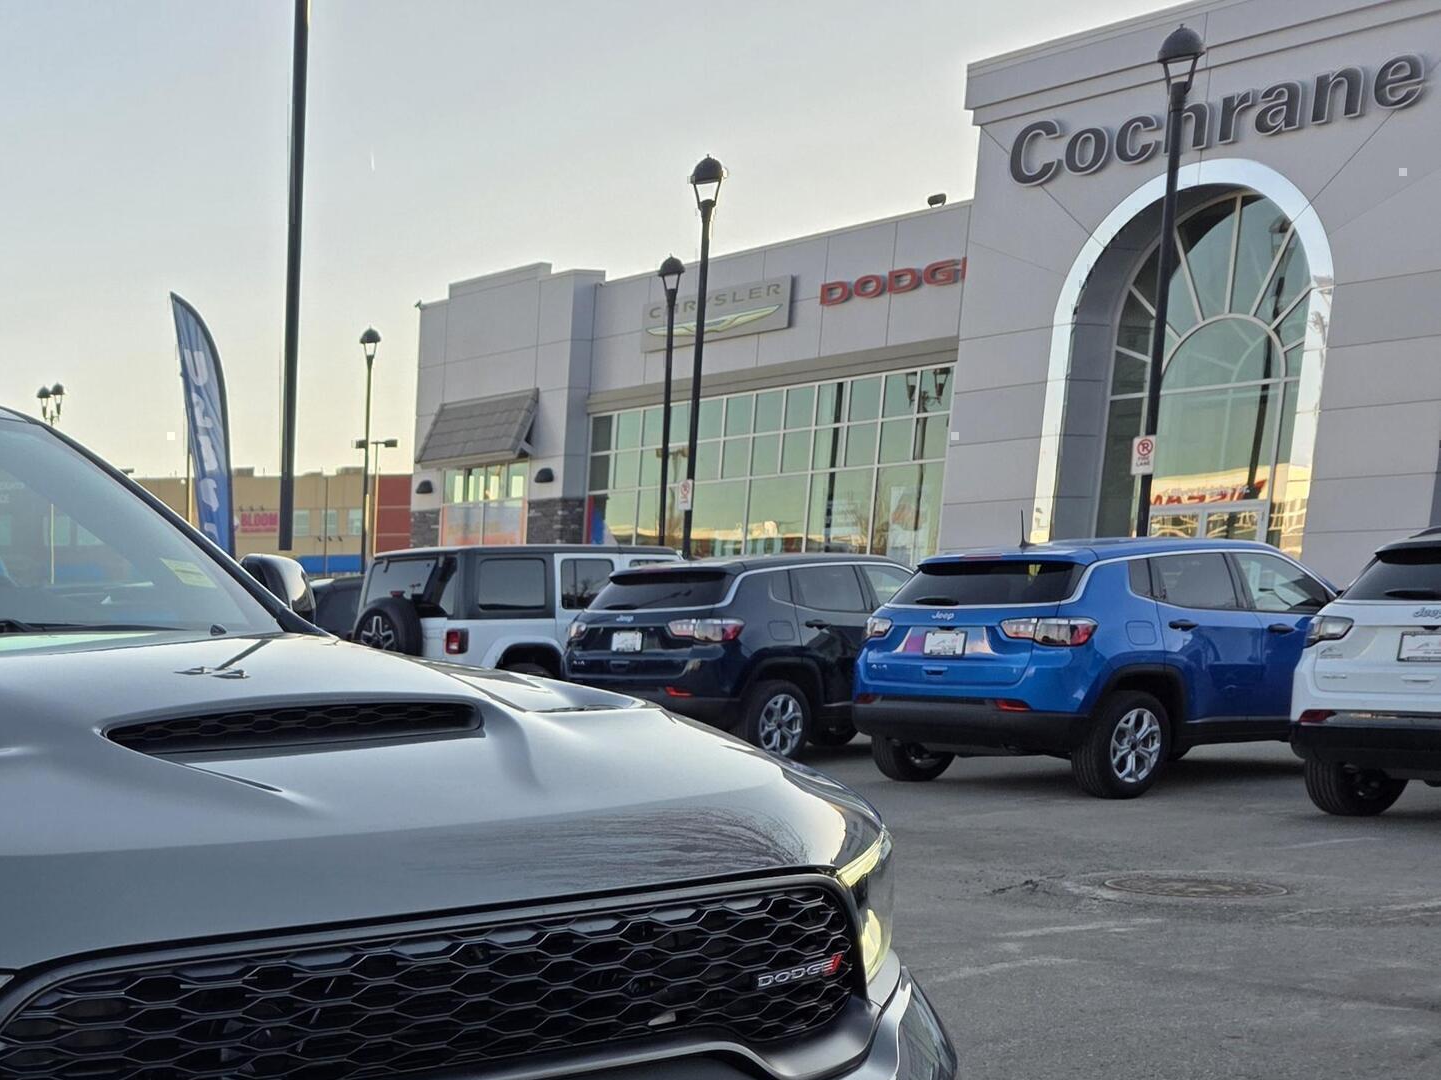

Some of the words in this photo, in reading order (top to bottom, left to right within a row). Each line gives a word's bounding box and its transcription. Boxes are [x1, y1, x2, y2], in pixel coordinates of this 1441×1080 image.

[1009, 53, 1429, 186] Cochrane
[649, 284, 781, 319] CRSLER
[931, 611, 955, 620] Jeep
[758, 960, 835, 987] DODGE
